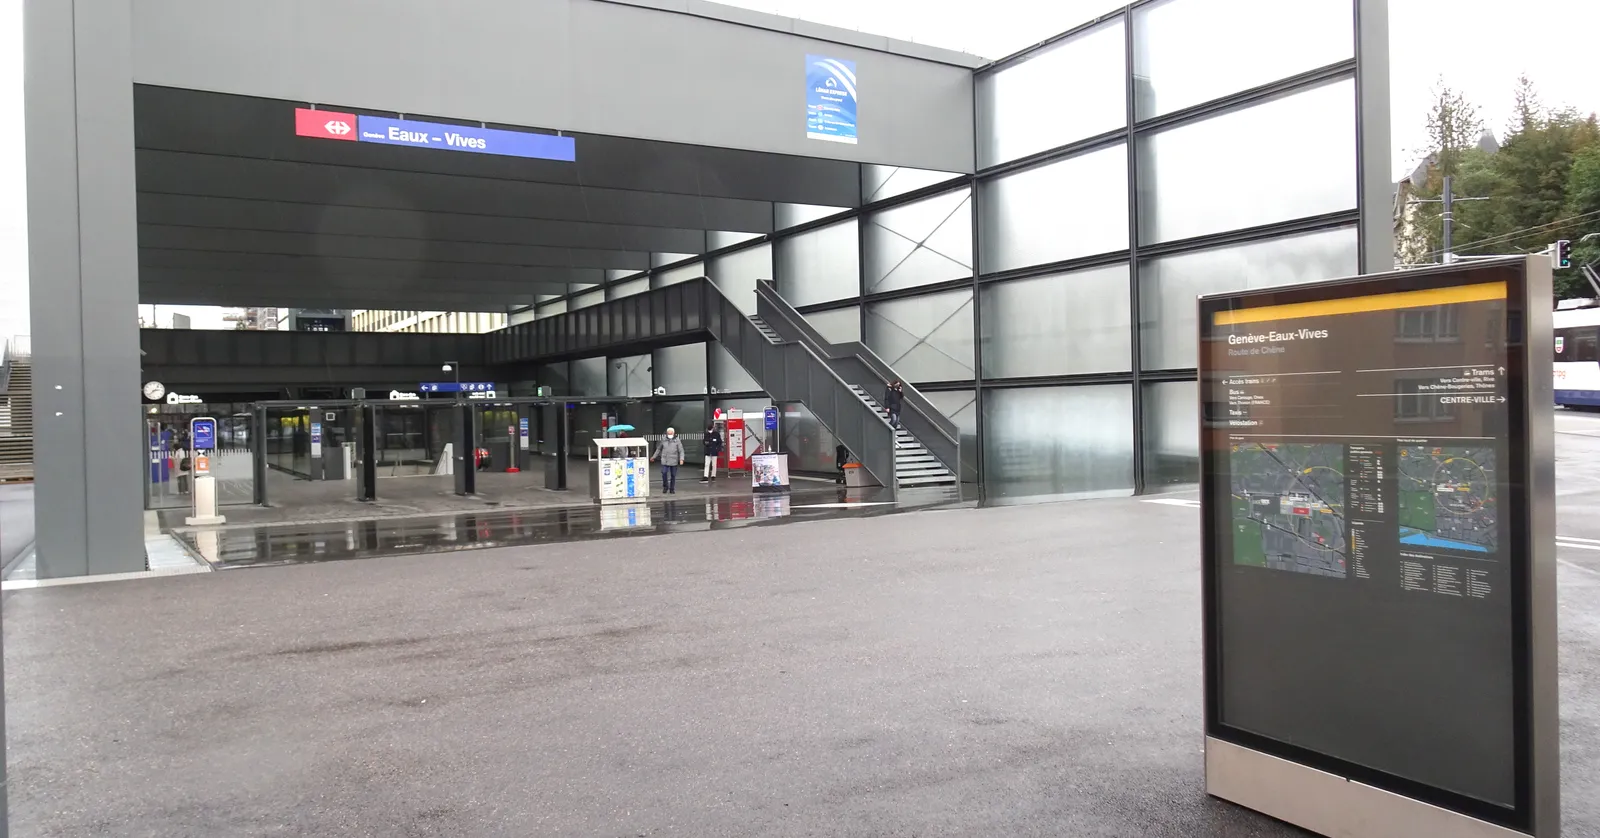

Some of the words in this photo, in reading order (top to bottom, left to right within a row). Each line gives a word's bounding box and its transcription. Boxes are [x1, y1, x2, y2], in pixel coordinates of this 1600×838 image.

[388, 126, 429, 143] Eaux
[444, 132, 487, 149] Vives
[1228, 328, 1329, 345] Genève-Eaux-Vives
[1228, 348, 1249, 356] Route
[1250, 347, 1260, 355] de
[1440, 395, 1496, 404] CENTRE-VILLE
